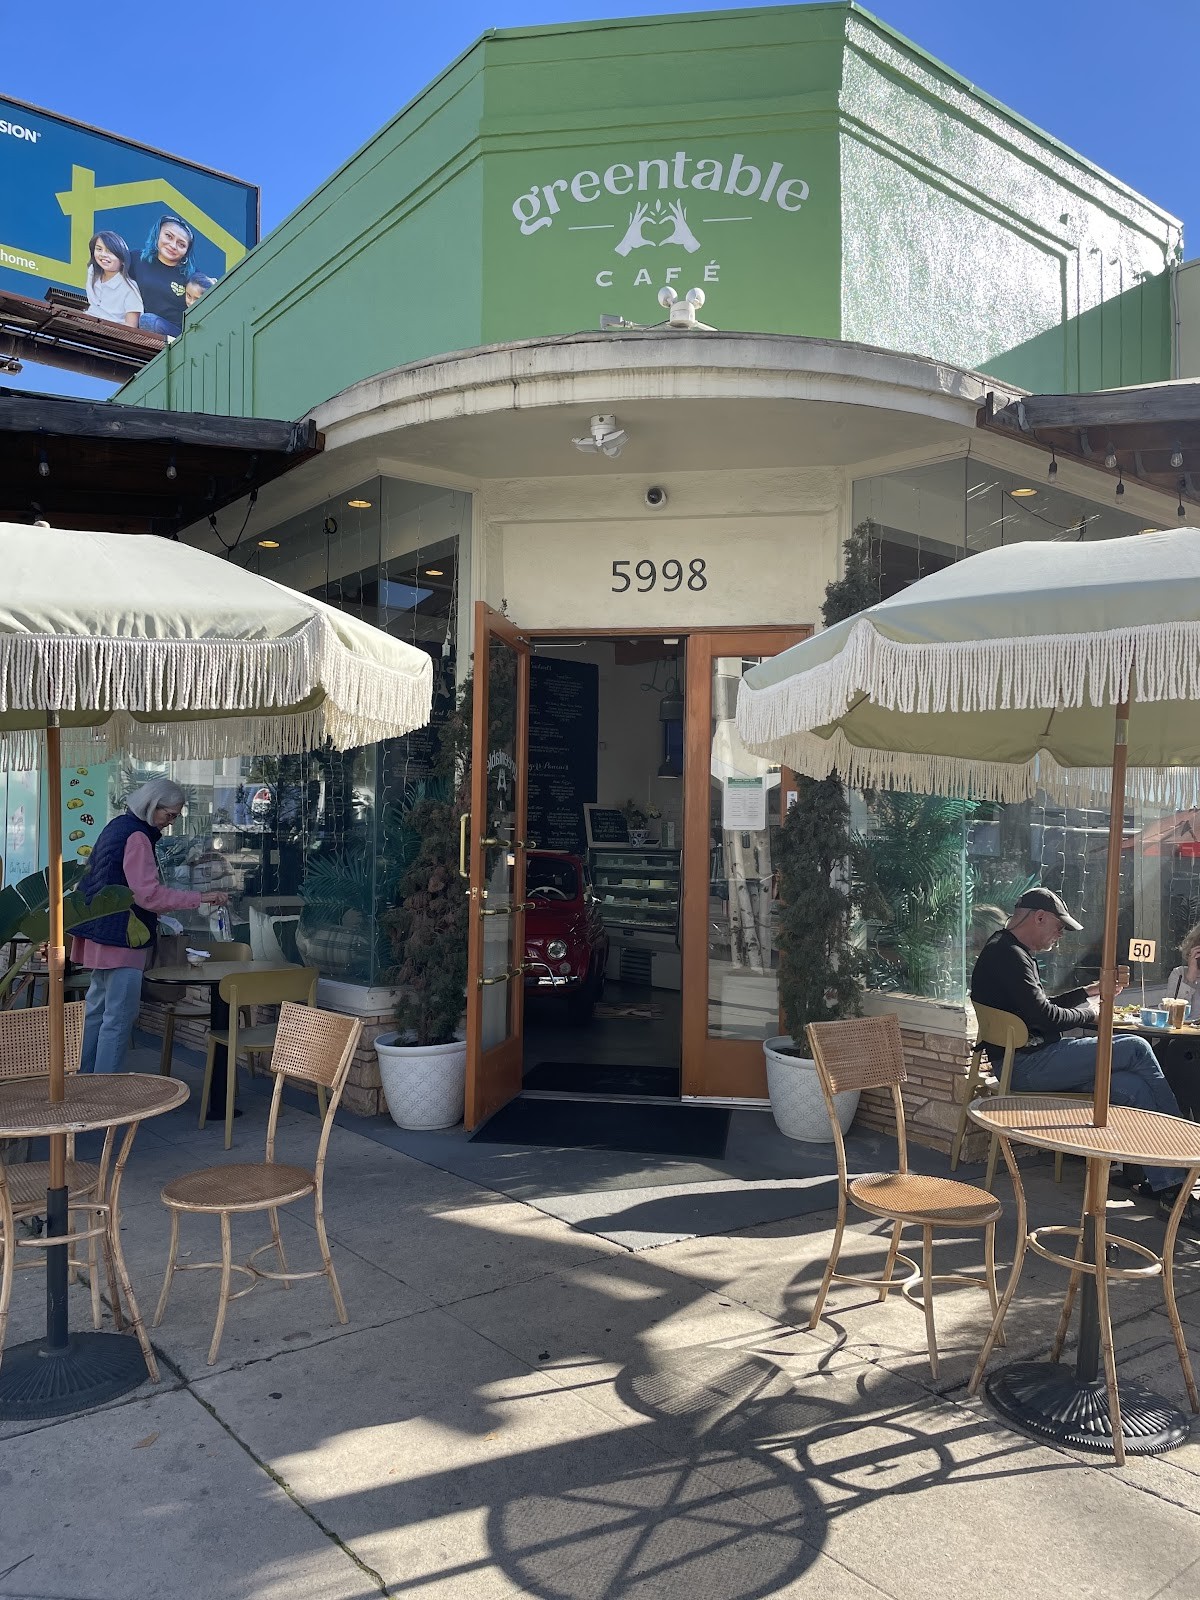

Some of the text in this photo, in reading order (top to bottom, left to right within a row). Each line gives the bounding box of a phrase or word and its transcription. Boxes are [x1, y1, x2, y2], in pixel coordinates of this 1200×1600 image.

[511, 151, 810, 236] greentable
[0, 249, 39, 271] home.
[595, 259, 721, 287] CAFÉ
[611, 558, 707, 593] 5998
[1133, 942, 1151, 958] 50
